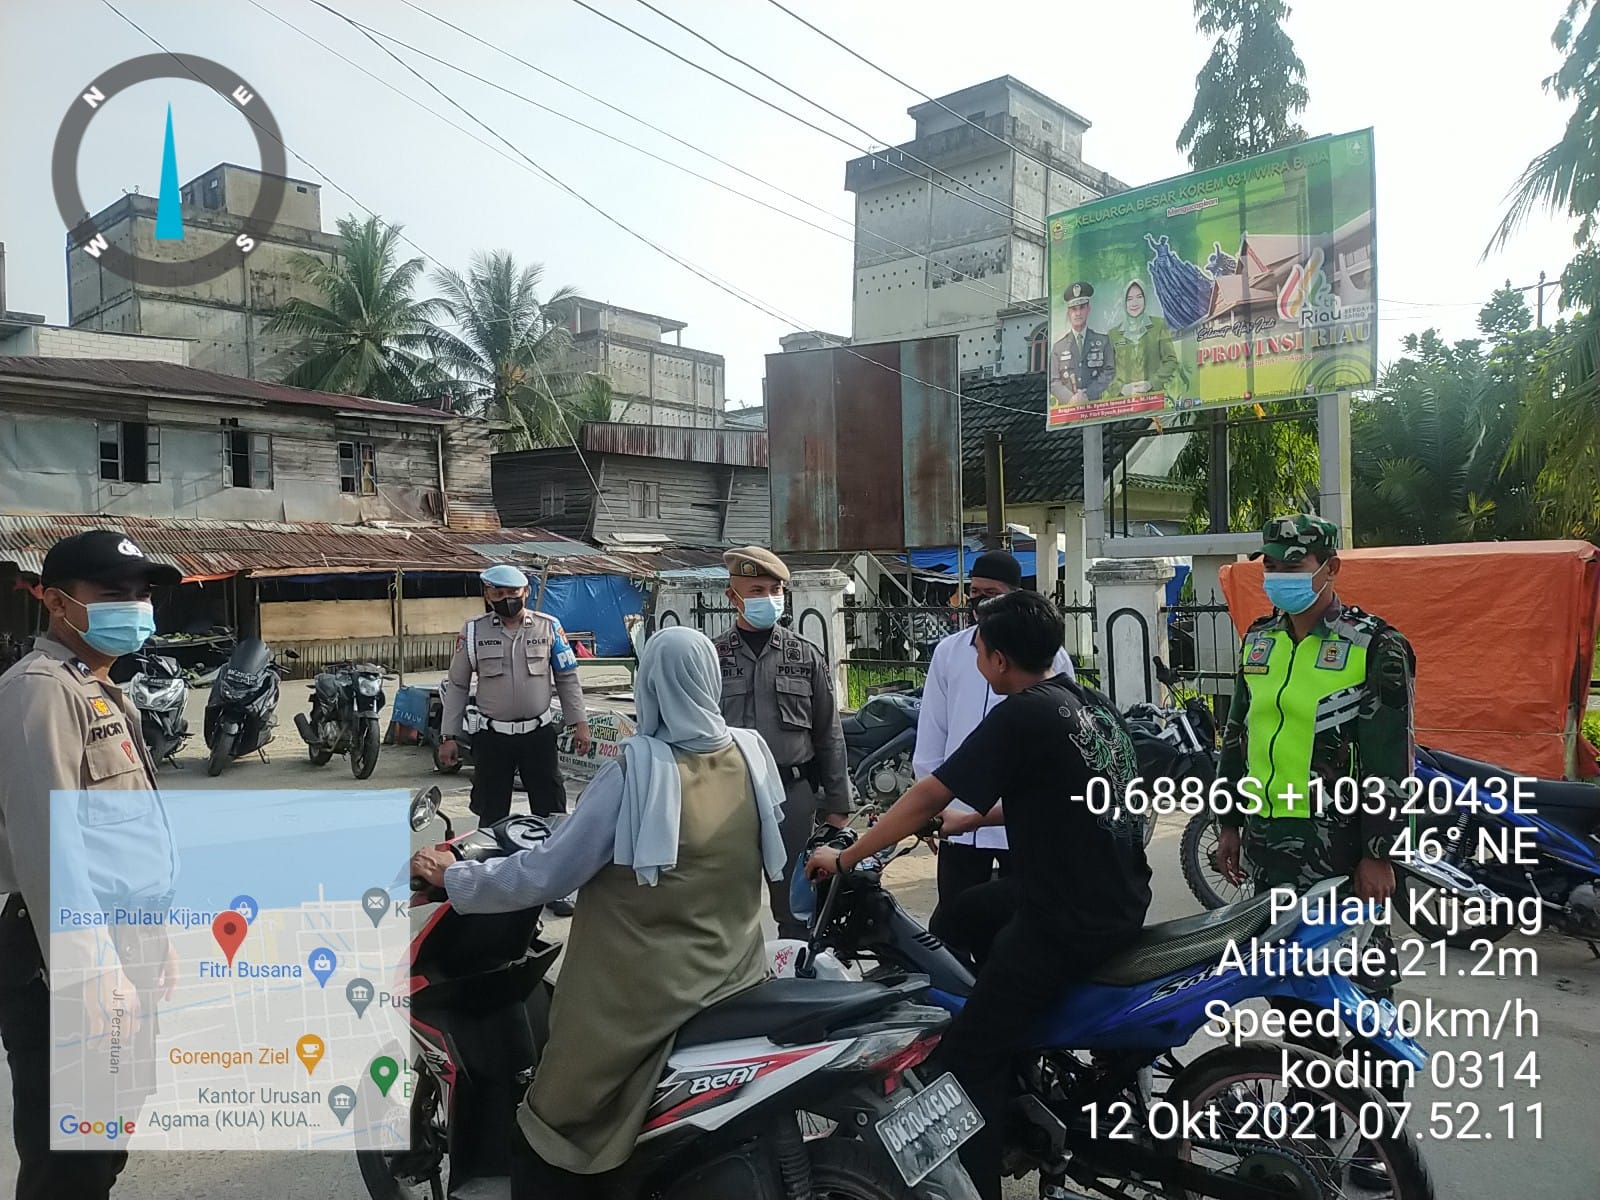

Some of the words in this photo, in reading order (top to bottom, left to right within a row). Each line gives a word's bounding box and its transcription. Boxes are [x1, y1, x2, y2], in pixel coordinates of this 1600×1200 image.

[1074, 203, 1135, 228] KELUARGA
[1137, 191, 1176, 211] BESAR
[1178, 178, 1224, 199] KOREM
[1255, 160, 1290, 181] WIRA
[1167, 197, 1219, 217] Mengucapkan
[1302, 308, 1341, 326] Riau
[1198, 330, 1304, 366] PROVINSI
[1311, 321, 1372, 349] RIAU
[598, 743, 619, 757] 2020
